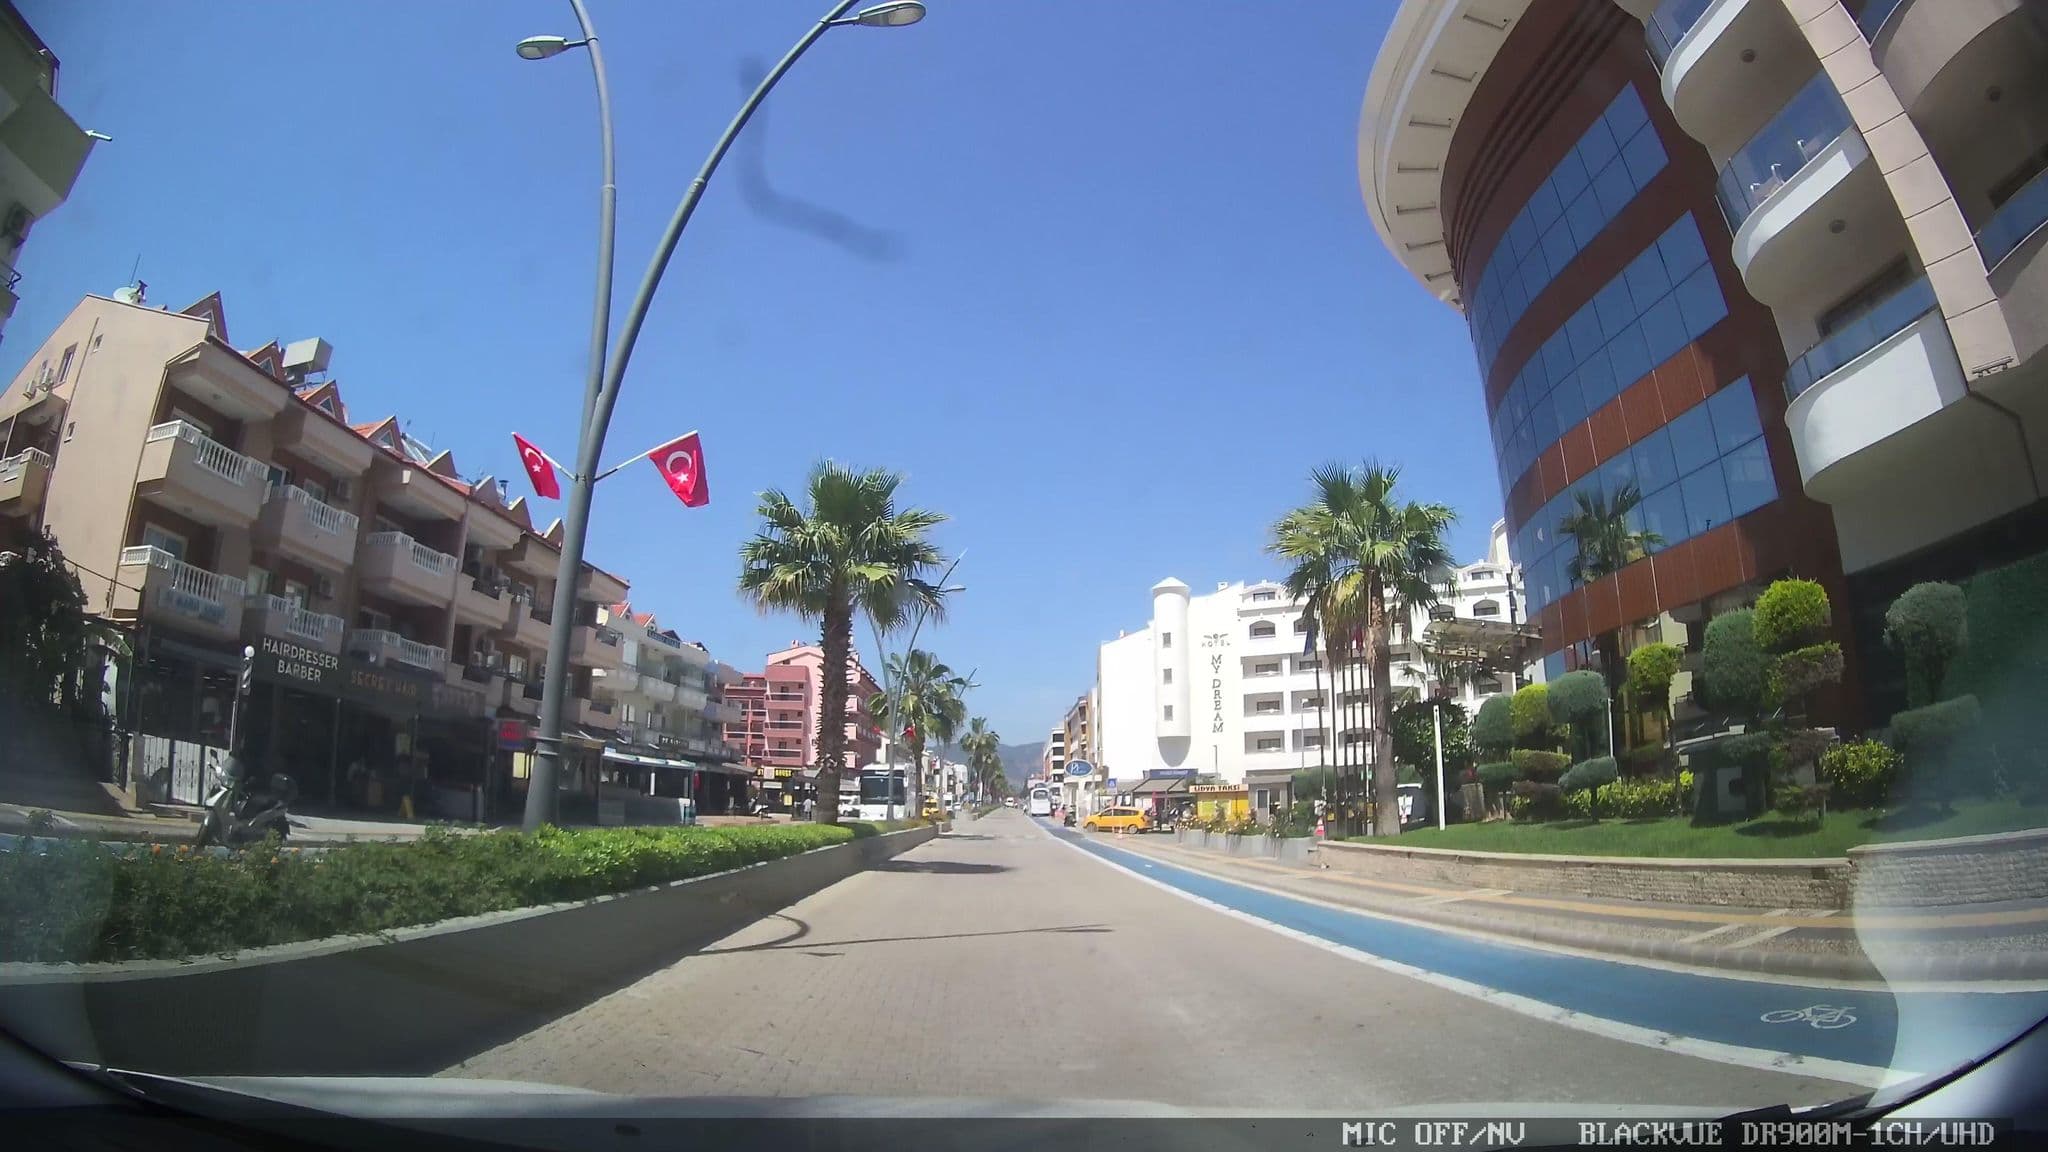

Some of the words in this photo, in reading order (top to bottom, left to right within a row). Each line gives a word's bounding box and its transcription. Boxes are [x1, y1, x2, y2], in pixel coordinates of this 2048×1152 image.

[263, 637, 339, 671] HAIRDRESSER
[1210, 653, 1223, 674] MY
[277, 659, 322, 683] BARBER
[1211, 678, 1224, 733] DREAM
